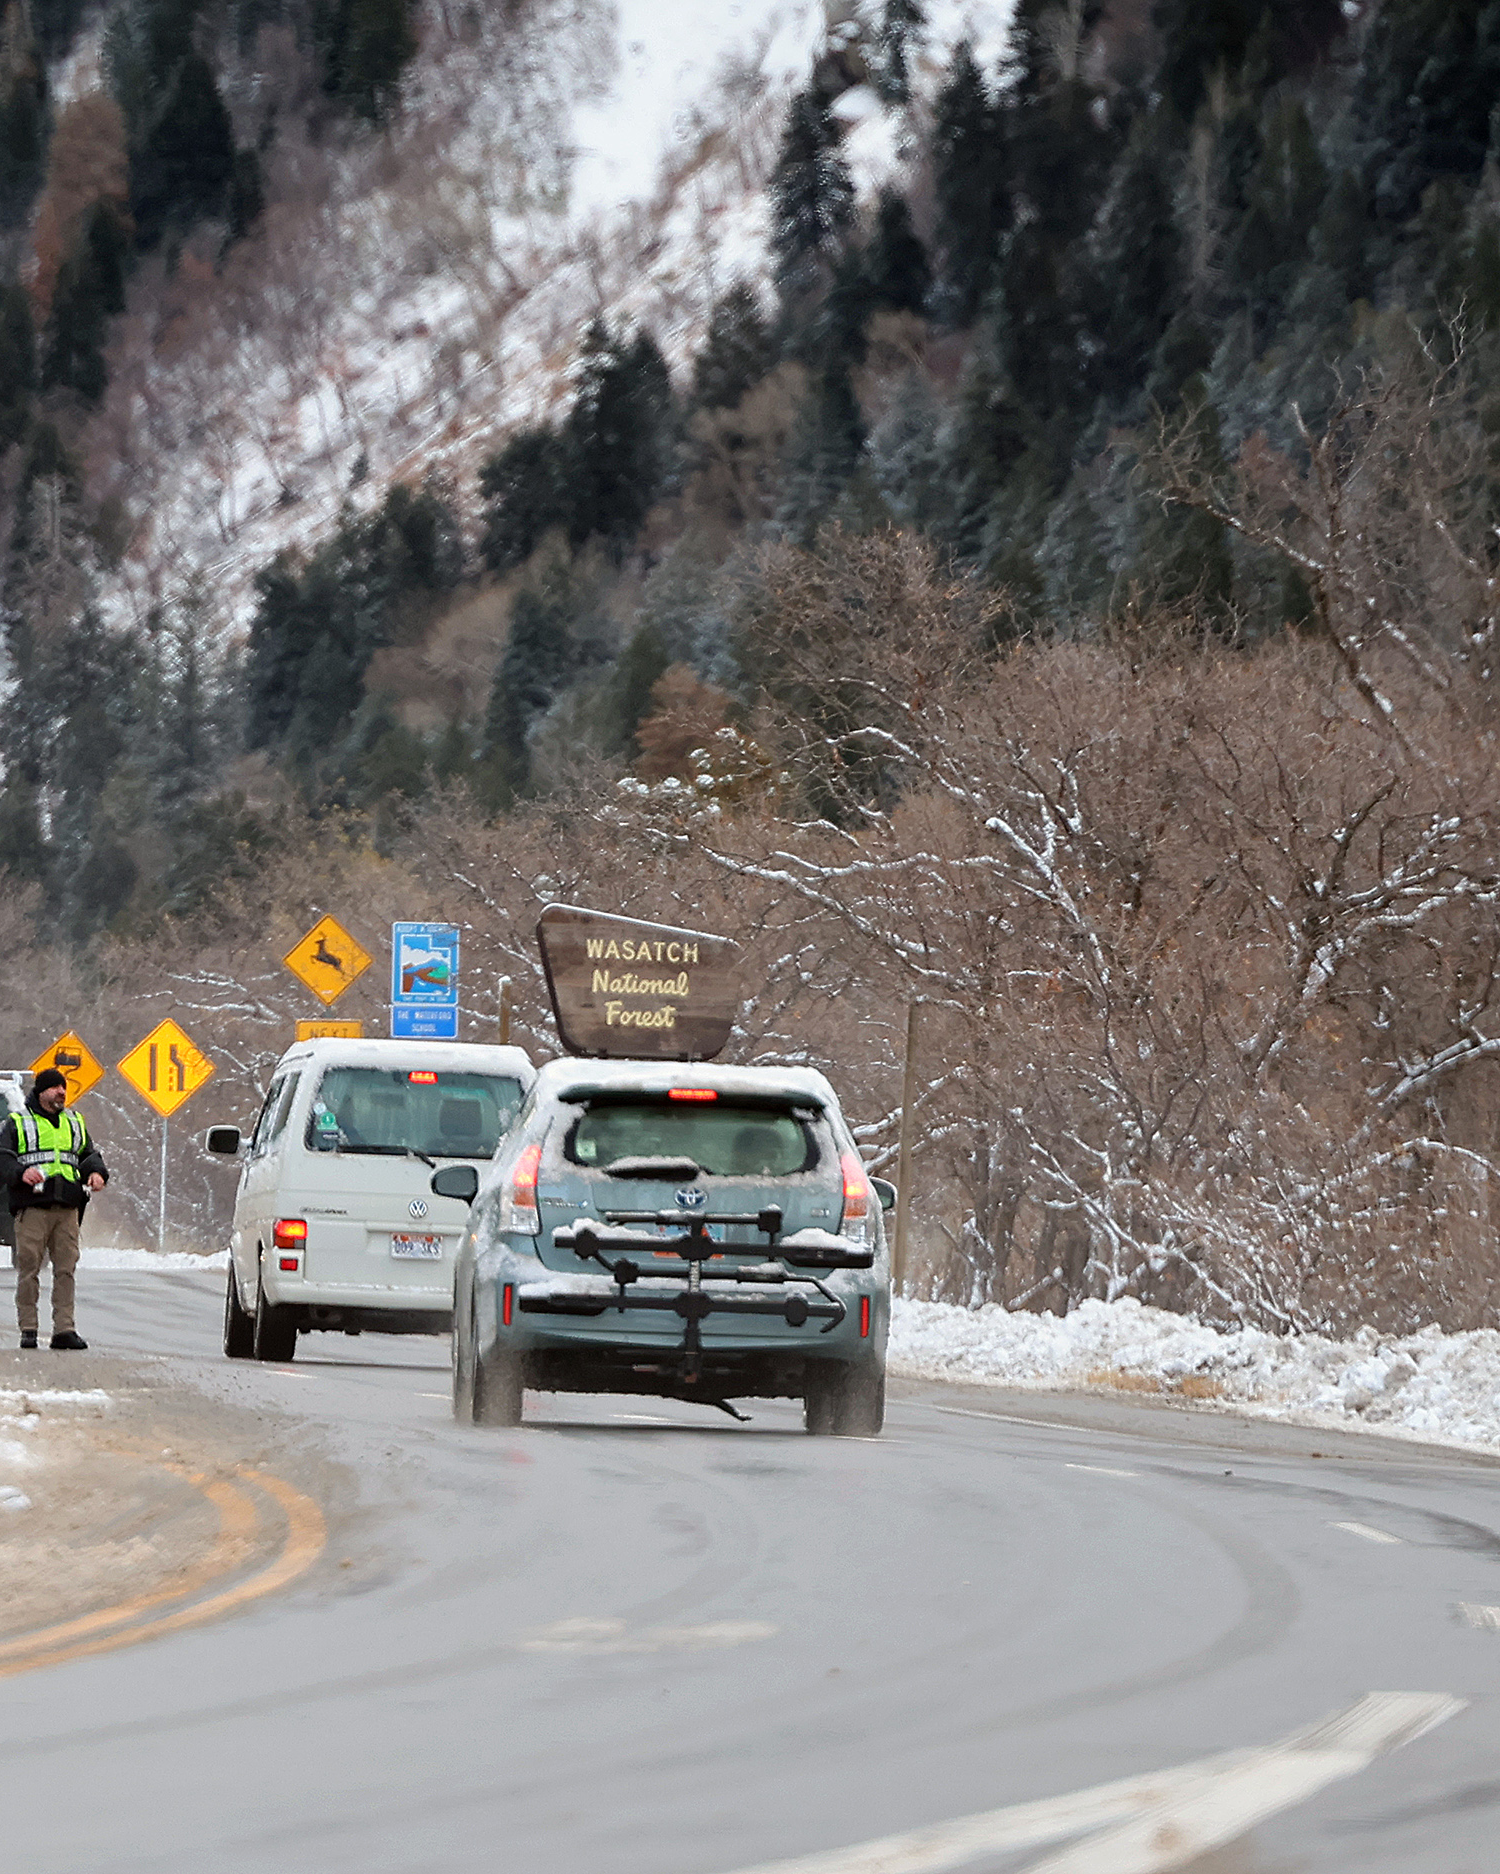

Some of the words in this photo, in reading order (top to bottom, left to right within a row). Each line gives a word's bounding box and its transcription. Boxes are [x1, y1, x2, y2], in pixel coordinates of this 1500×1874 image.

[586, 939, 699, 963] WASATCH
[592, 969, 689, 997] National
[604, 1000, 676, 1028] Forest
